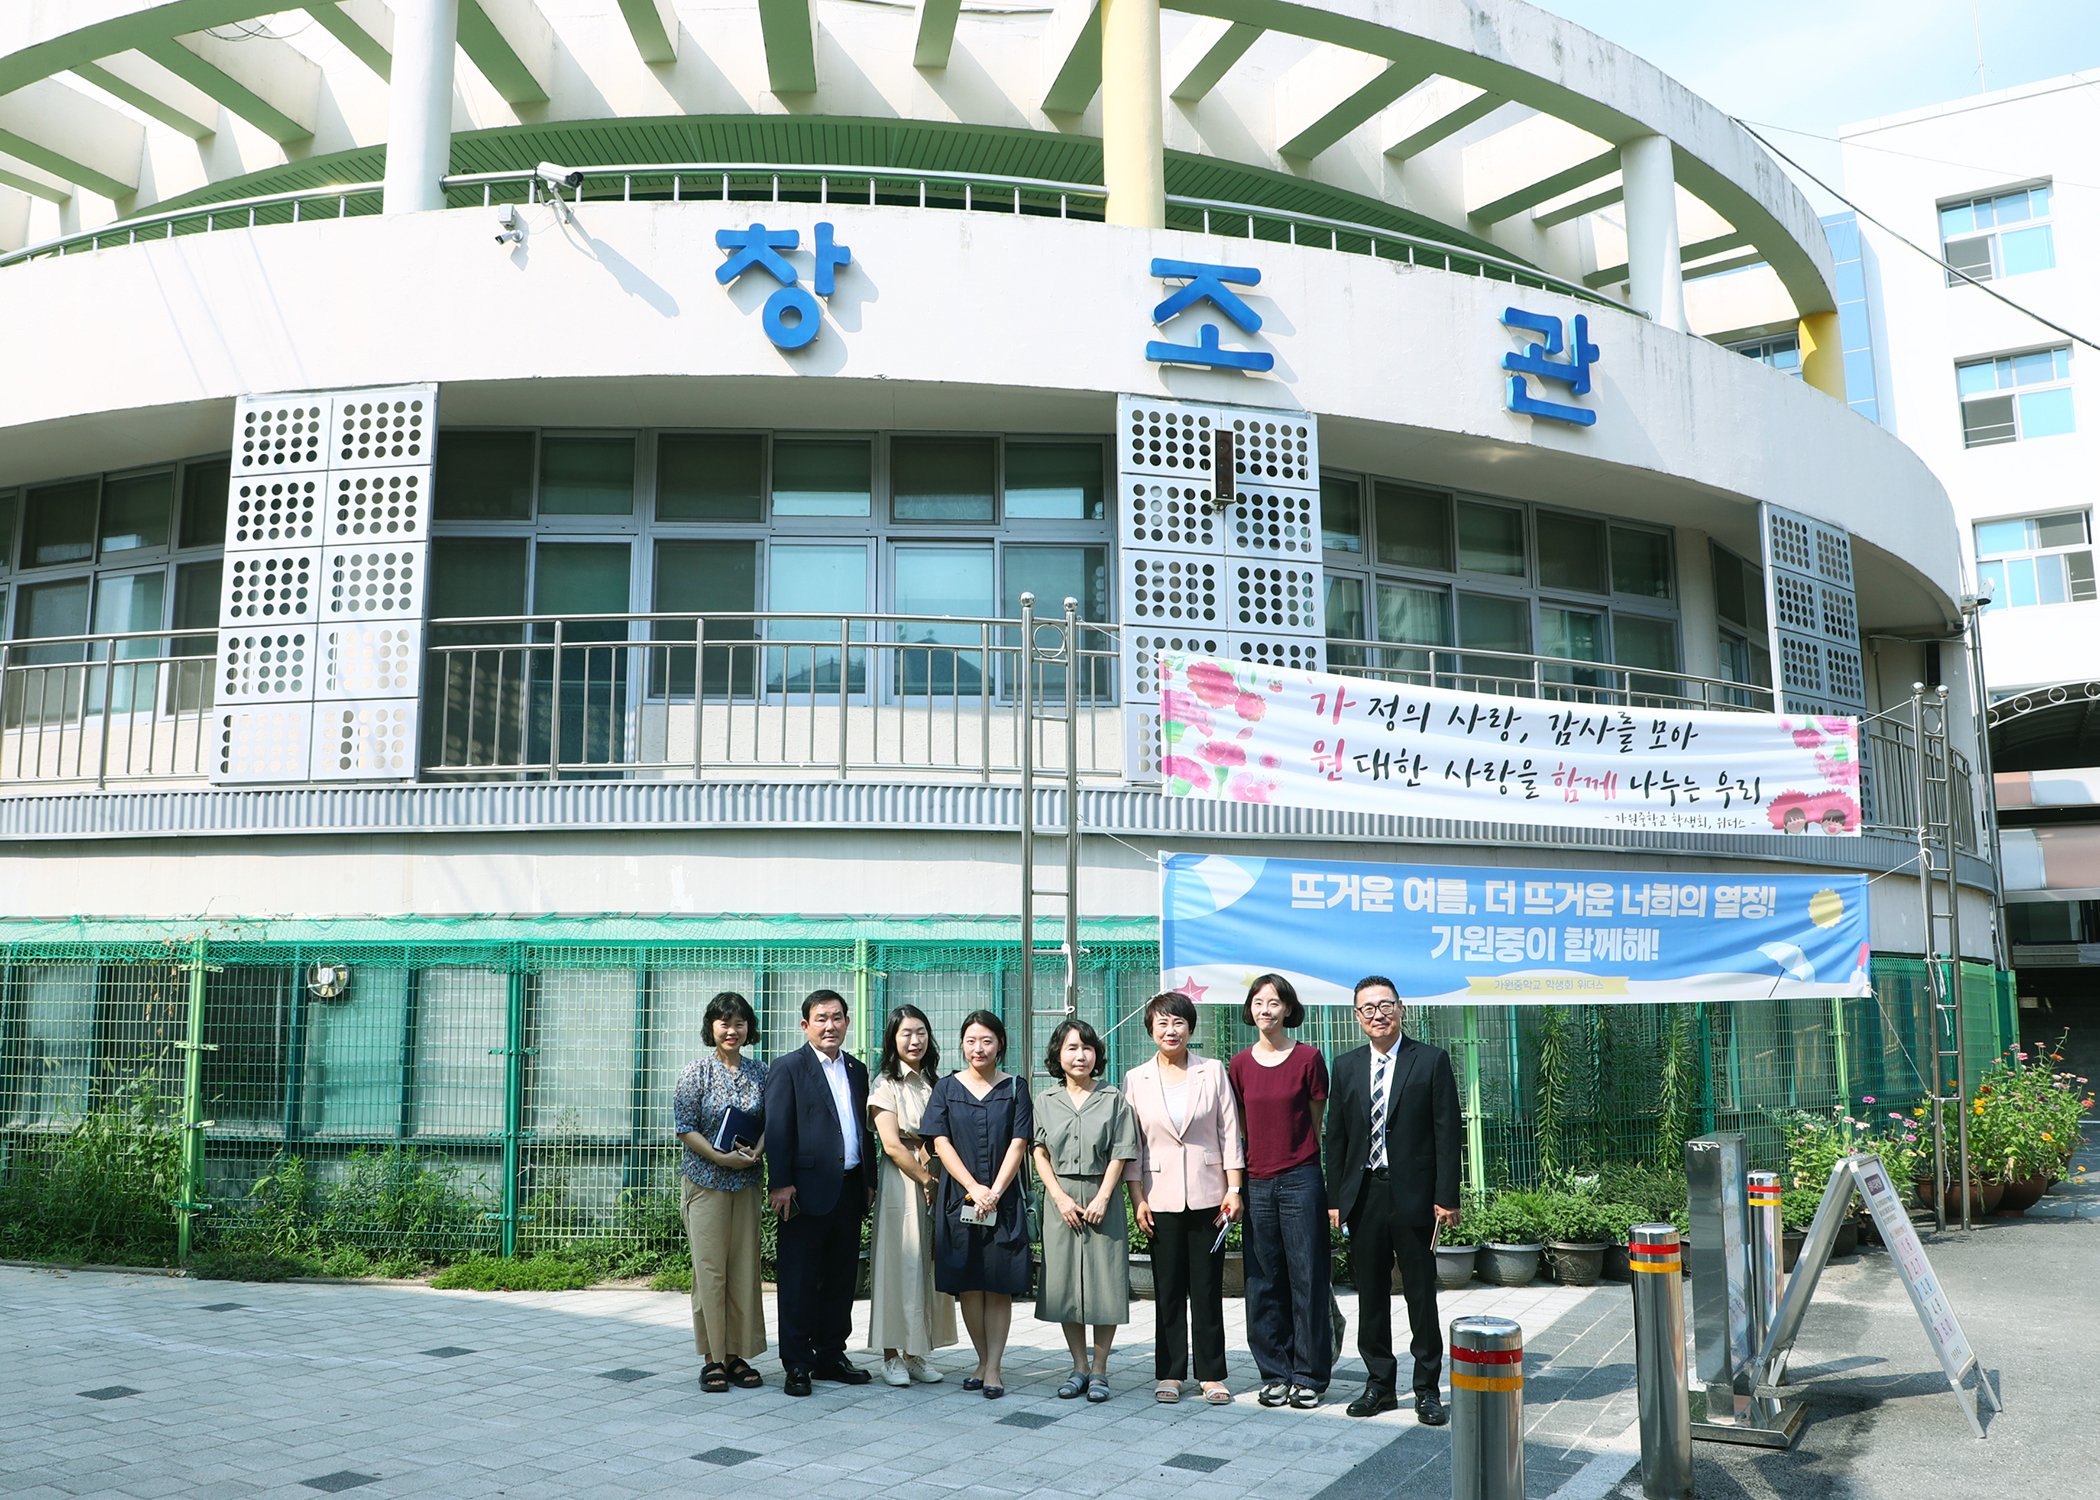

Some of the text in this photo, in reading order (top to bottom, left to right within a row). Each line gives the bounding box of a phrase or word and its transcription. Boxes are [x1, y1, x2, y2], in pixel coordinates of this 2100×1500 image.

[1448, 703, 1529, 744] 사랑,
[1548, 710, 1637, 754] 감사를
[1649, 718, 1699, 751] 모아
[1445, 757, 1540, 800] 사랑을
[1551, 761, 1618, 804] 함께
[1630, 770, 1701, 807] 나누는
[1715, 770, 1762, 809] 우리
[1615, 811, 1667, 828] 가원중학교
[1671, 812, 1712, 830] 학생회,
[1291, 872, 1777, 920] 뜨거운 여름, 더 뜨거운 너희의 열정!
[1430, 924, 1660, 963] 가원중이 함께해!
[1494, 979, 1605, 991] 가원중학교 학생회 위더스
